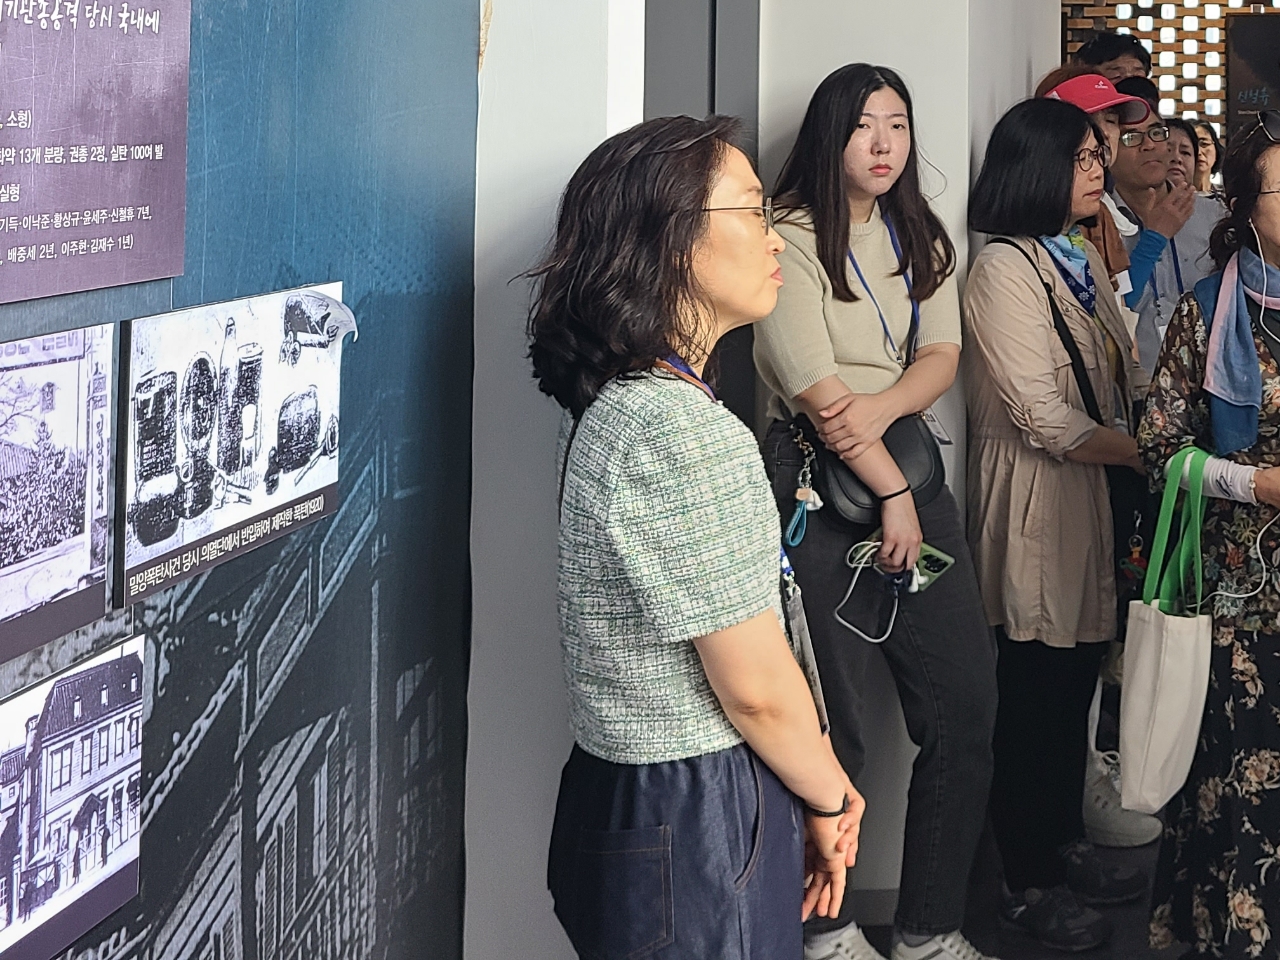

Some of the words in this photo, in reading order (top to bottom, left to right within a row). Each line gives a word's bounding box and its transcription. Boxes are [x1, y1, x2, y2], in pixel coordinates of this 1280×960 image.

[84, 0, 113, 28] 당시
[117, 2, 160, 35] 국내에
[6, 109, 32, 129] 소형)
[19, 146, 41, 165] 13개
[43, 145, 67, 165] 분량,
[69, 144, 88, 163] 권총
[90, 143, 108, 163] 2정,
[110, 143, 128, 162] 실탄
[130, 143, 153, 161] 100여
[154, 143, 164, 160] 발
[137, 205, 152, 221] 7년,
[7, 244, 36, 263] 배중세
[39, 242, 58, 259] 2년,
[117, 233, 134, 249] 1년)
[129, 562, 182, 596] 밀양폭탄사건
[182, 547, 200, 571] 당시
[200, 533, 240, 562] 의열단에서
[241, 520, 271, 546] 반입하여
[271, 507, 293, 531] 제작한
